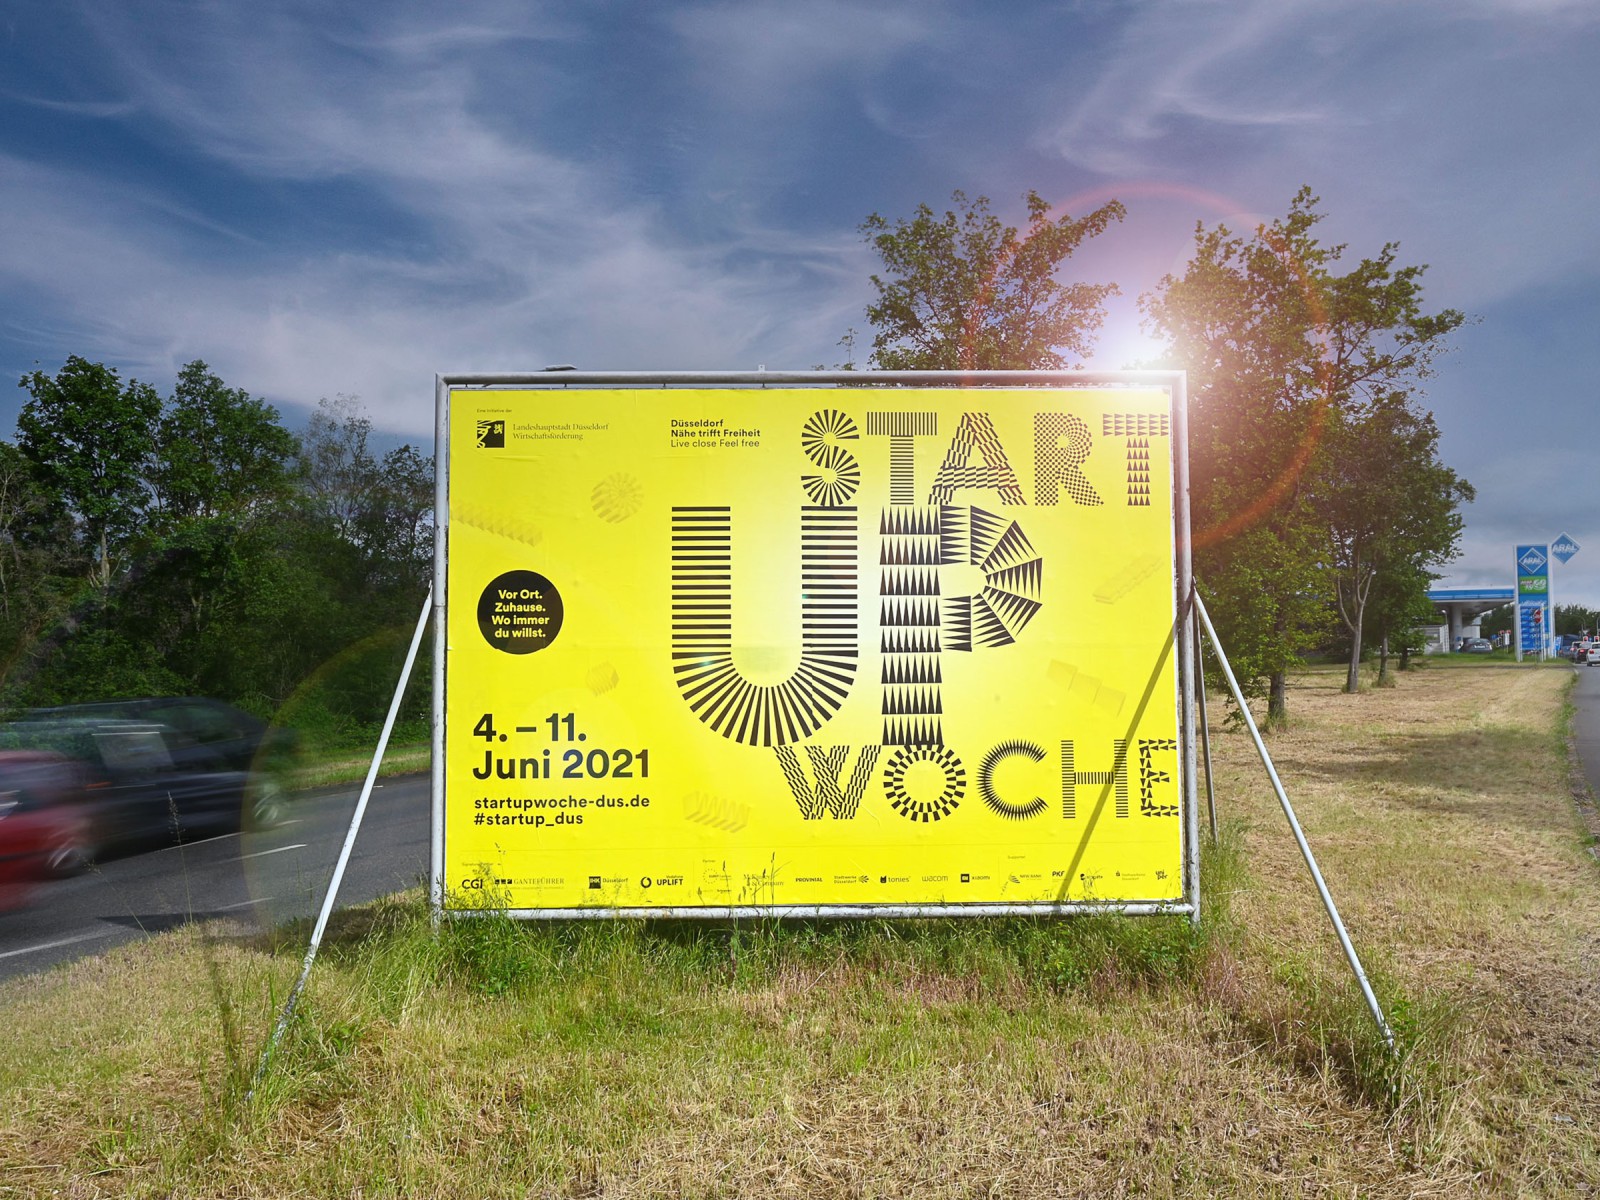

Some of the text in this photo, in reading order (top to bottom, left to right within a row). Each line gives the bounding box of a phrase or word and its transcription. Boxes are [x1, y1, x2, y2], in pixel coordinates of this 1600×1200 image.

[512, 423, 609, 432] Landeshauptstadt Düsseldorf
[670, 418, 724, 428] Düsseldorf
[512, 432, 584, 441] Wirtschaftsförderung
[670, 428, 761, 438] Nähe trifft Freiheit
[670, 438, 760, 448] Live close Feel free
[800, 408, 1170, 507] START
[1552, 543, 1578, 553] ARAL
[1522, 556, 1542, 564] ARAL
[498, 589, 543, 600] Vor Ort.
[494, 602, 546, 613] Zuhause.
[491, 614, 550, 625] Wo immer
[671, 504, 1043, 747] UP
[494, 628, 546, 638] du willst.
[473, 748, 649, 780] Juni 2021
[772, 738, 1180, 822] WOCHE
[474, 794, 650, 811] startupwoche-dus.de
[473, 811, 584, 828] #startup_dus
[461, 879, 483, 889] CGI
[513, 877, 565, 885] GANTEFÜHRER
[656, 878, 684, 886] UPLIFT
